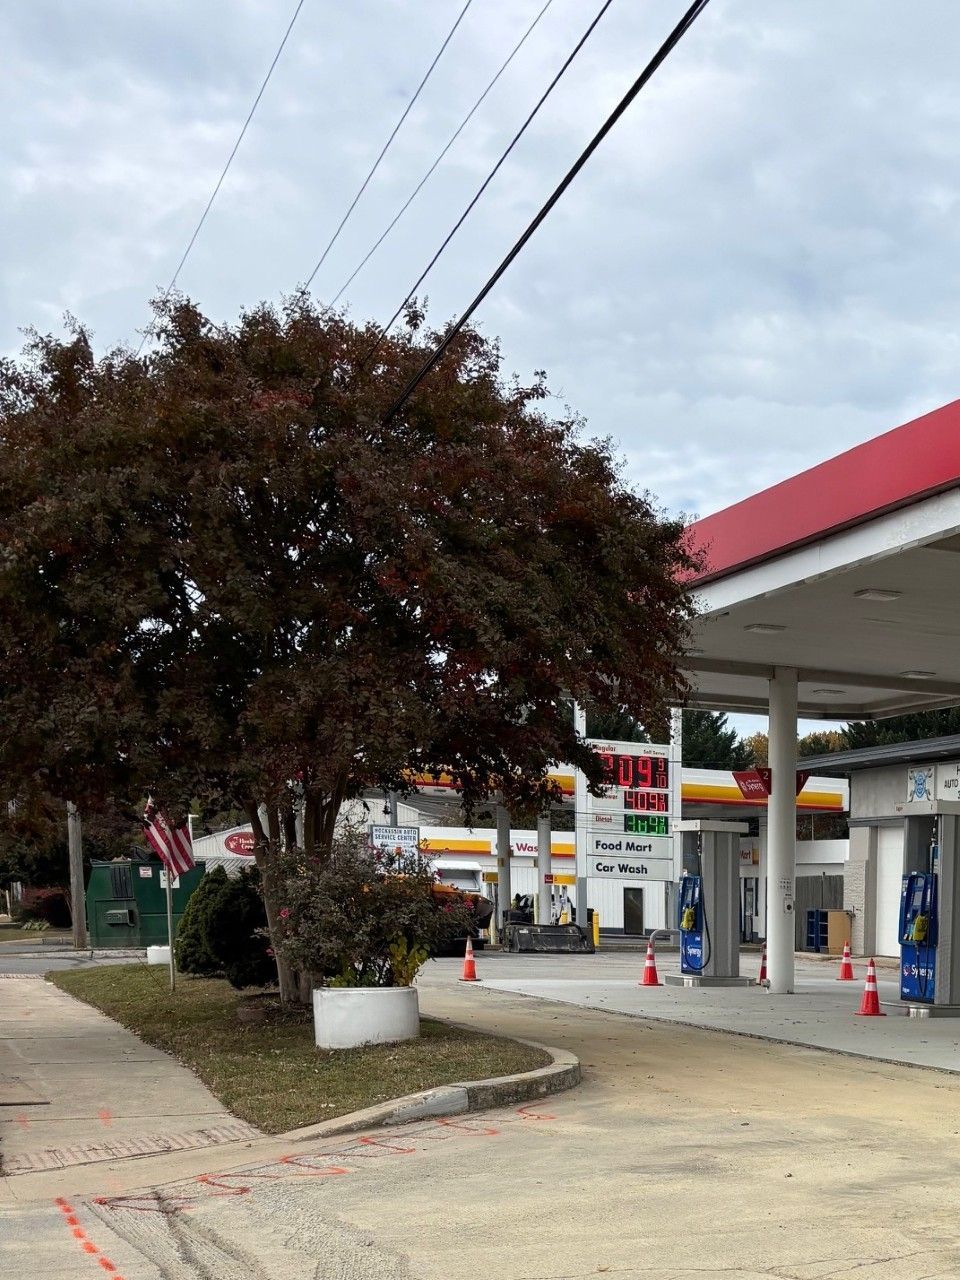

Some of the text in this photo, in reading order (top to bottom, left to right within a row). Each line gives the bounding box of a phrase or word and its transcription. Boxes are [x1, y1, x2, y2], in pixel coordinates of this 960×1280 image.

[763, 771, 769, 780] 2
[944, 779, 959, 789] AUTO
[595, 840, 652, 852] Food Mart
[595, 862, 648, 874] Car Wash
